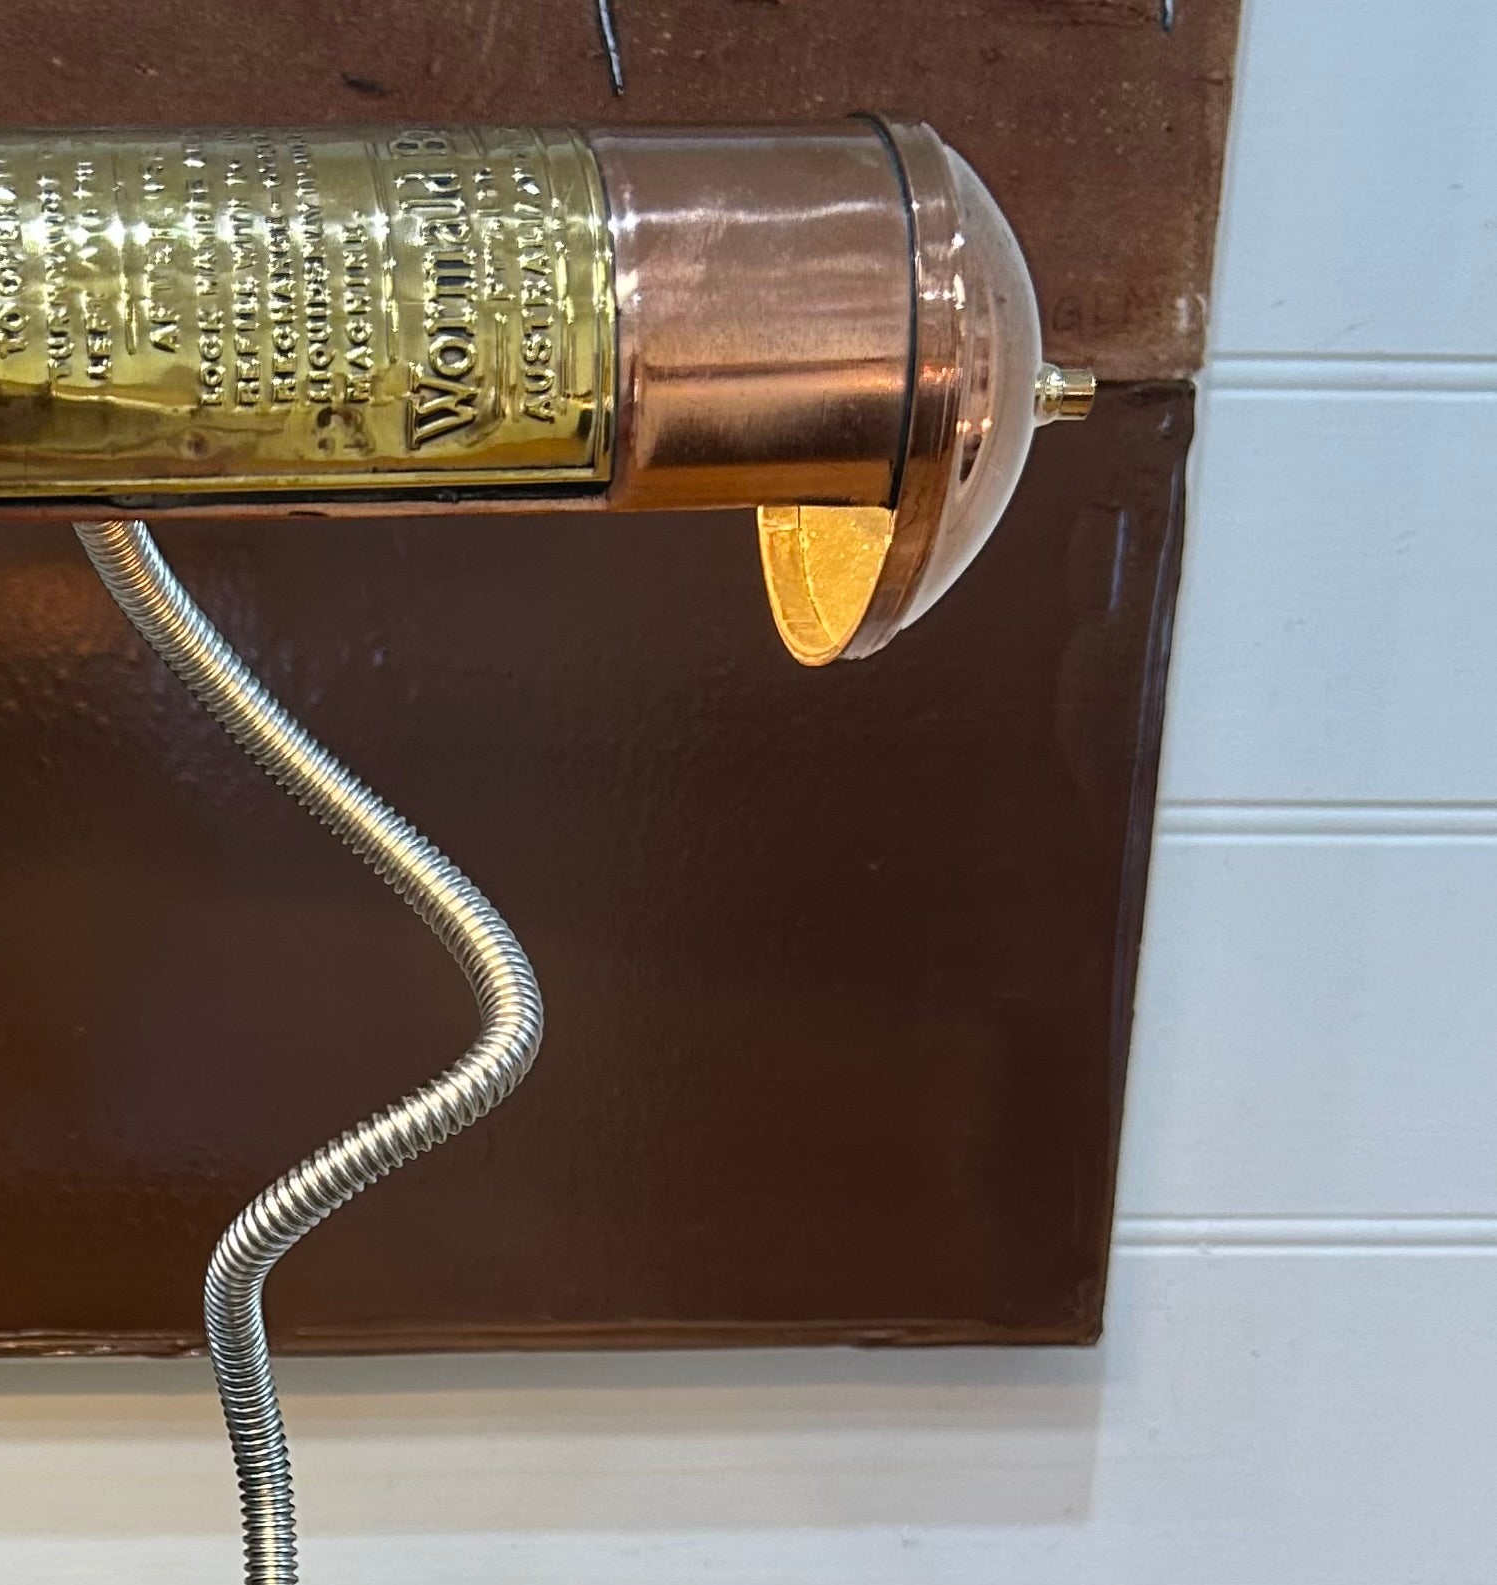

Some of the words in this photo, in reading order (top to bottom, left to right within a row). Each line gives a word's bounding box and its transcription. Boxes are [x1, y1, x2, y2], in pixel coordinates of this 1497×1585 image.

[198, 309, 225, 406] LOCK
[232, 277, 261, 406] REFILL
[303, 259, 332, 404] LIQUIDS
[393, 172, 479, 450] Wormald
